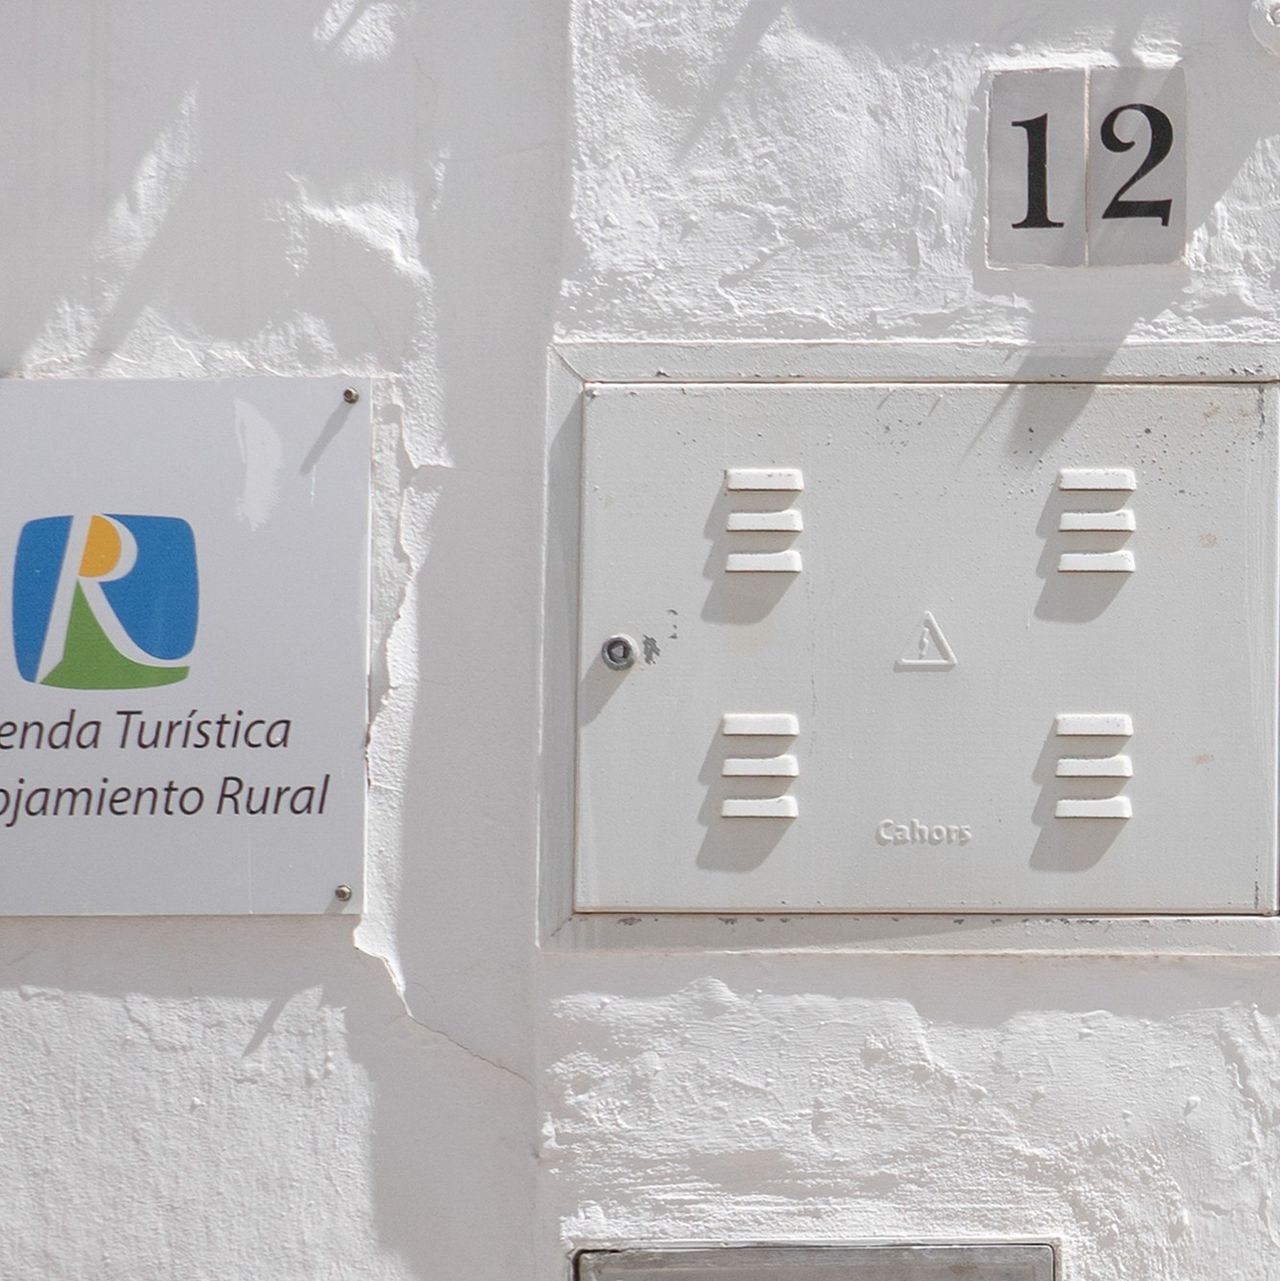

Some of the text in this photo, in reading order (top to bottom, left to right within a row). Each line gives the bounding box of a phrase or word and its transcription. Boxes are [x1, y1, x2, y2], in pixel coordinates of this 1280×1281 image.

[1011, 103, 1174, 229] 12
[0, 708, 292, 750] enda Turística
[215, 773, 331, 816] Rural
[877, 818, 973, 844] Cahors
